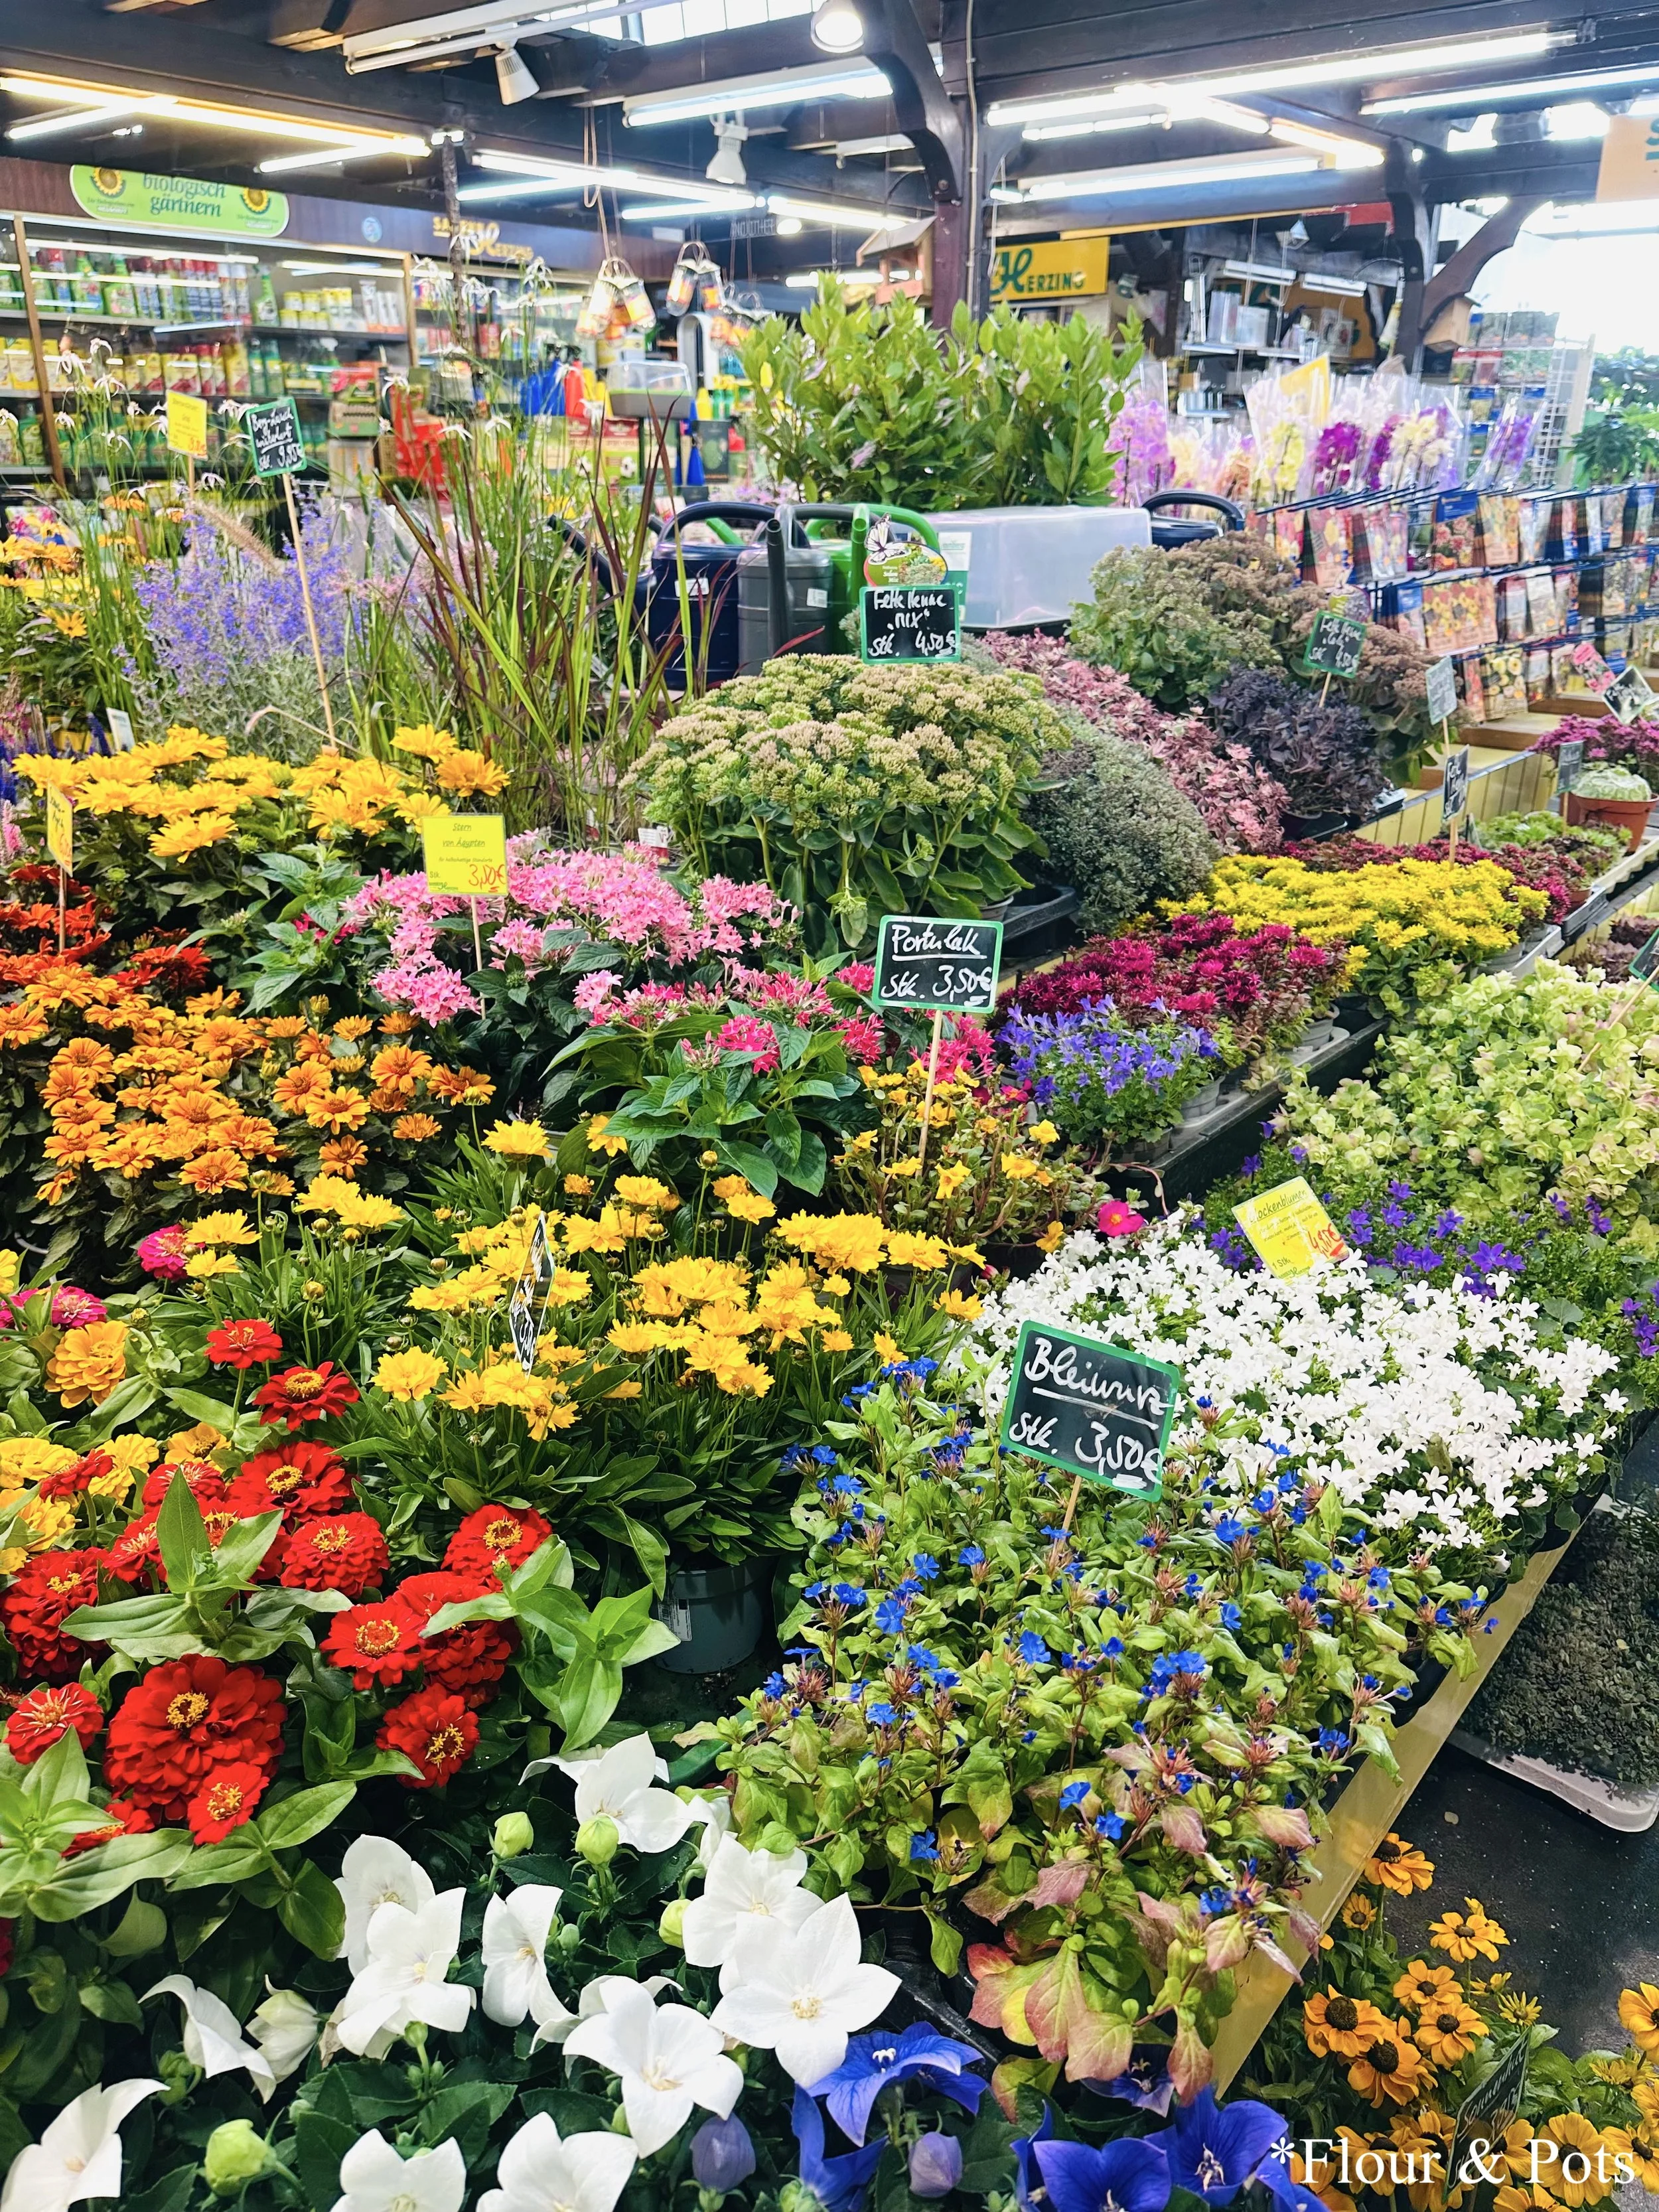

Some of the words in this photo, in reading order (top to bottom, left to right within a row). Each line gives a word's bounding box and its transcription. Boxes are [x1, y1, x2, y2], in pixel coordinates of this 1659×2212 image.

[151, 194, 222, 218] gärtnern
[873, 588, 904, 610] Fette
[907, 587, 947, 609] Henne
[868, 632, 901, 656] Stk.
[457, 836, 485, 848] Ägypten
[892, 923, 981, 955] Portulak
[881, 971, 925, 999] Stk.
[932, 965, 993, 1002] 3,50€
[1250, 1189, 1307, 1222] lockenblumen
[1024, 1337, 1174, 1416] Bleiwurz
[1009, 1412, 1058, 1455] Stk.
[1074, 1421, 1163, 1485] 3,50€
[1457, 2033, 1528, 2139] Sonnenhut
